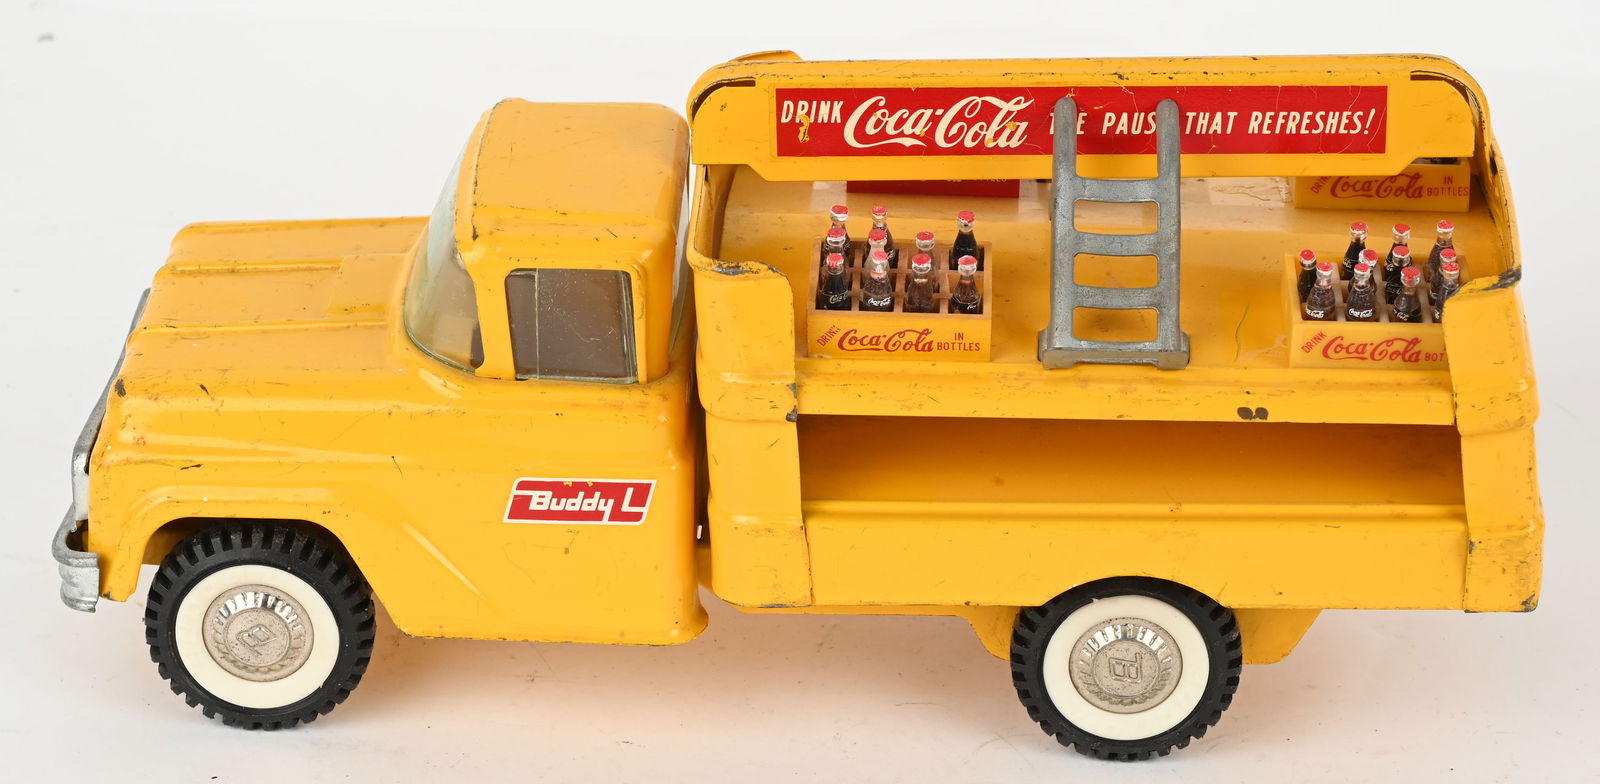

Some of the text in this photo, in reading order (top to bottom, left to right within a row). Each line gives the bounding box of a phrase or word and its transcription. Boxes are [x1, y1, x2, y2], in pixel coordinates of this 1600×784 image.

[780, 95, 1376, 149] DRINK Coca-Cola TE PAUS THAT REFRESHES!
[1330, 172, 1424, 200] Coca-Cola
[1426, 186, 1469, 196] BOTTLES
[1444, 175, 1454, 185] IN
[837, 328, 934, 353] Coca-Cola
[936, 342, 981, 352] BOTTLES
[954, 332, 964, 341] IN
[1301, 331, 1422, 363] DRINK Coca-Cola
[528, 487, 646, 522] Buddy L
